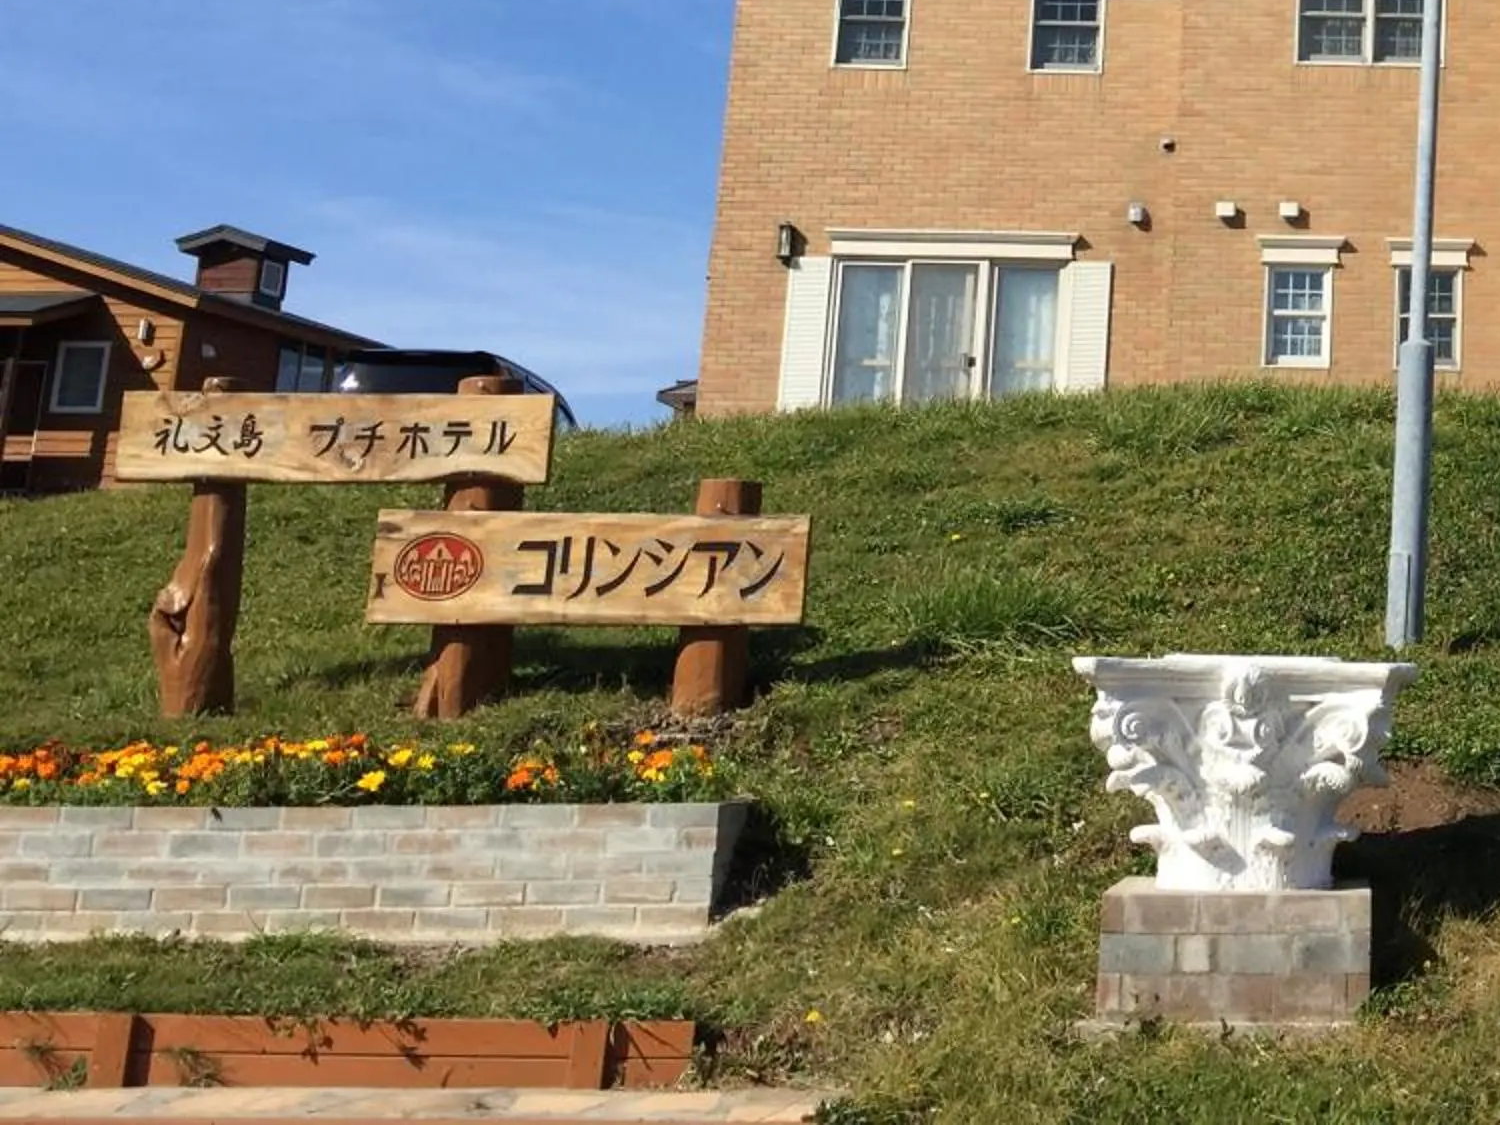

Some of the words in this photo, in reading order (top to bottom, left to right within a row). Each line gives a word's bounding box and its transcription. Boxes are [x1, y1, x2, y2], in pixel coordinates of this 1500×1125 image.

[154, 414, 265, 458] 礼文島
[309, 417, 518, 460] プチホテル
[511, 536, 785, 601] コリンシアン
